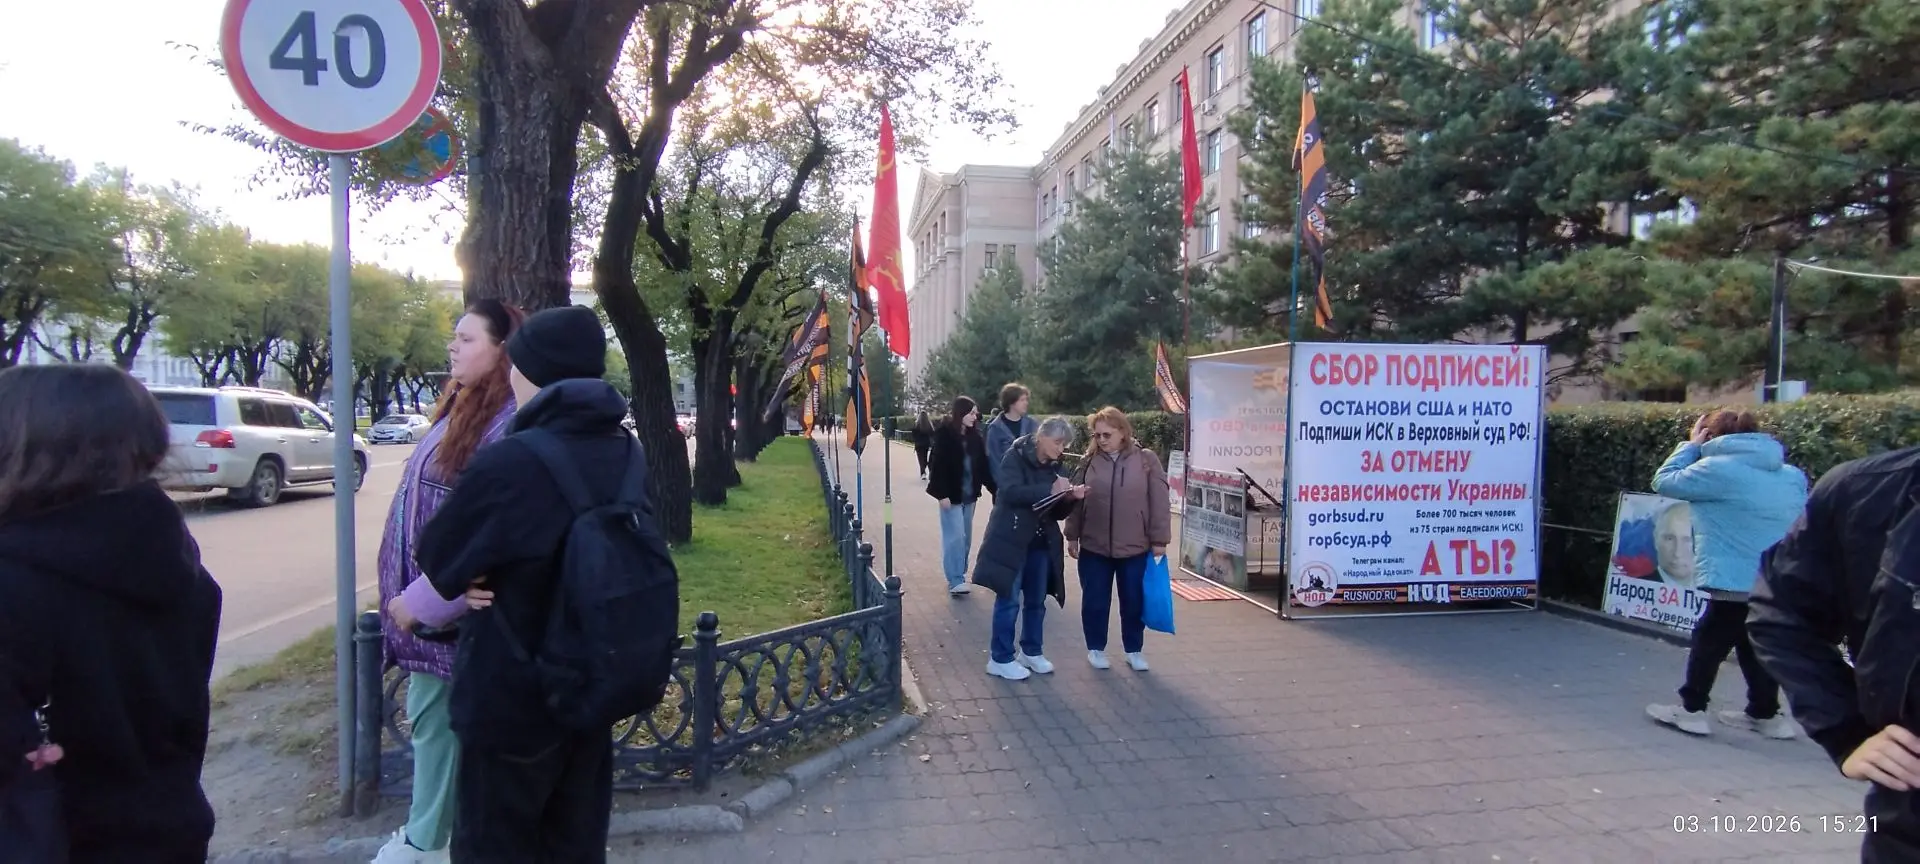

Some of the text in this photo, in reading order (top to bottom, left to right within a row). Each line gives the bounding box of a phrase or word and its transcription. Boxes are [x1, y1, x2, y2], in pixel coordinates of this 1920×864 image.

[269, 10, 387, 89] 40
[1309, 345, 1529, 392] СБОР ПОДПИСЕЙ!
[1320, 400, 1512, 416] ОСТАНОВИ США и НАТО
[1299, 419, 1530, 445] Подпиши ИСК в Верховный суд РФ!
[1360, 450, 1472, 472] ЗА ОТМЕНУ
[1299, 479, 1527, 505] независимости Украины
[1308, 508, 1384, 526] gorbsud.ru
[1416, 509, 1516, 518] Более 700 тысяч человек
[1421, 525, 1430, 533] 75
[1432, 526, 1455, 535] стран
[1457, 525, 1499, 534] подписали
[1501, 523, 1524, 532] ИСК!
[1308, 531, 1391, 548] горбсуд.рф
[1352, 557, 1382, 566] Телеграм
[1419, 539, 1516, 576] А ТЫ?
[1304, 592, 1326, 602] НОД
[1343, 589, 1397, 601] RUSNOD.RU
[1407, 583, 1450, 603] НОД
[1460, 586, 1528, 599] EAFEDOROV.RU
[1609, 576, 1655, 606] Народ
[1658, 586, 1680, 607] ЗА
[1634, 604, 1648, 614] ЗА
